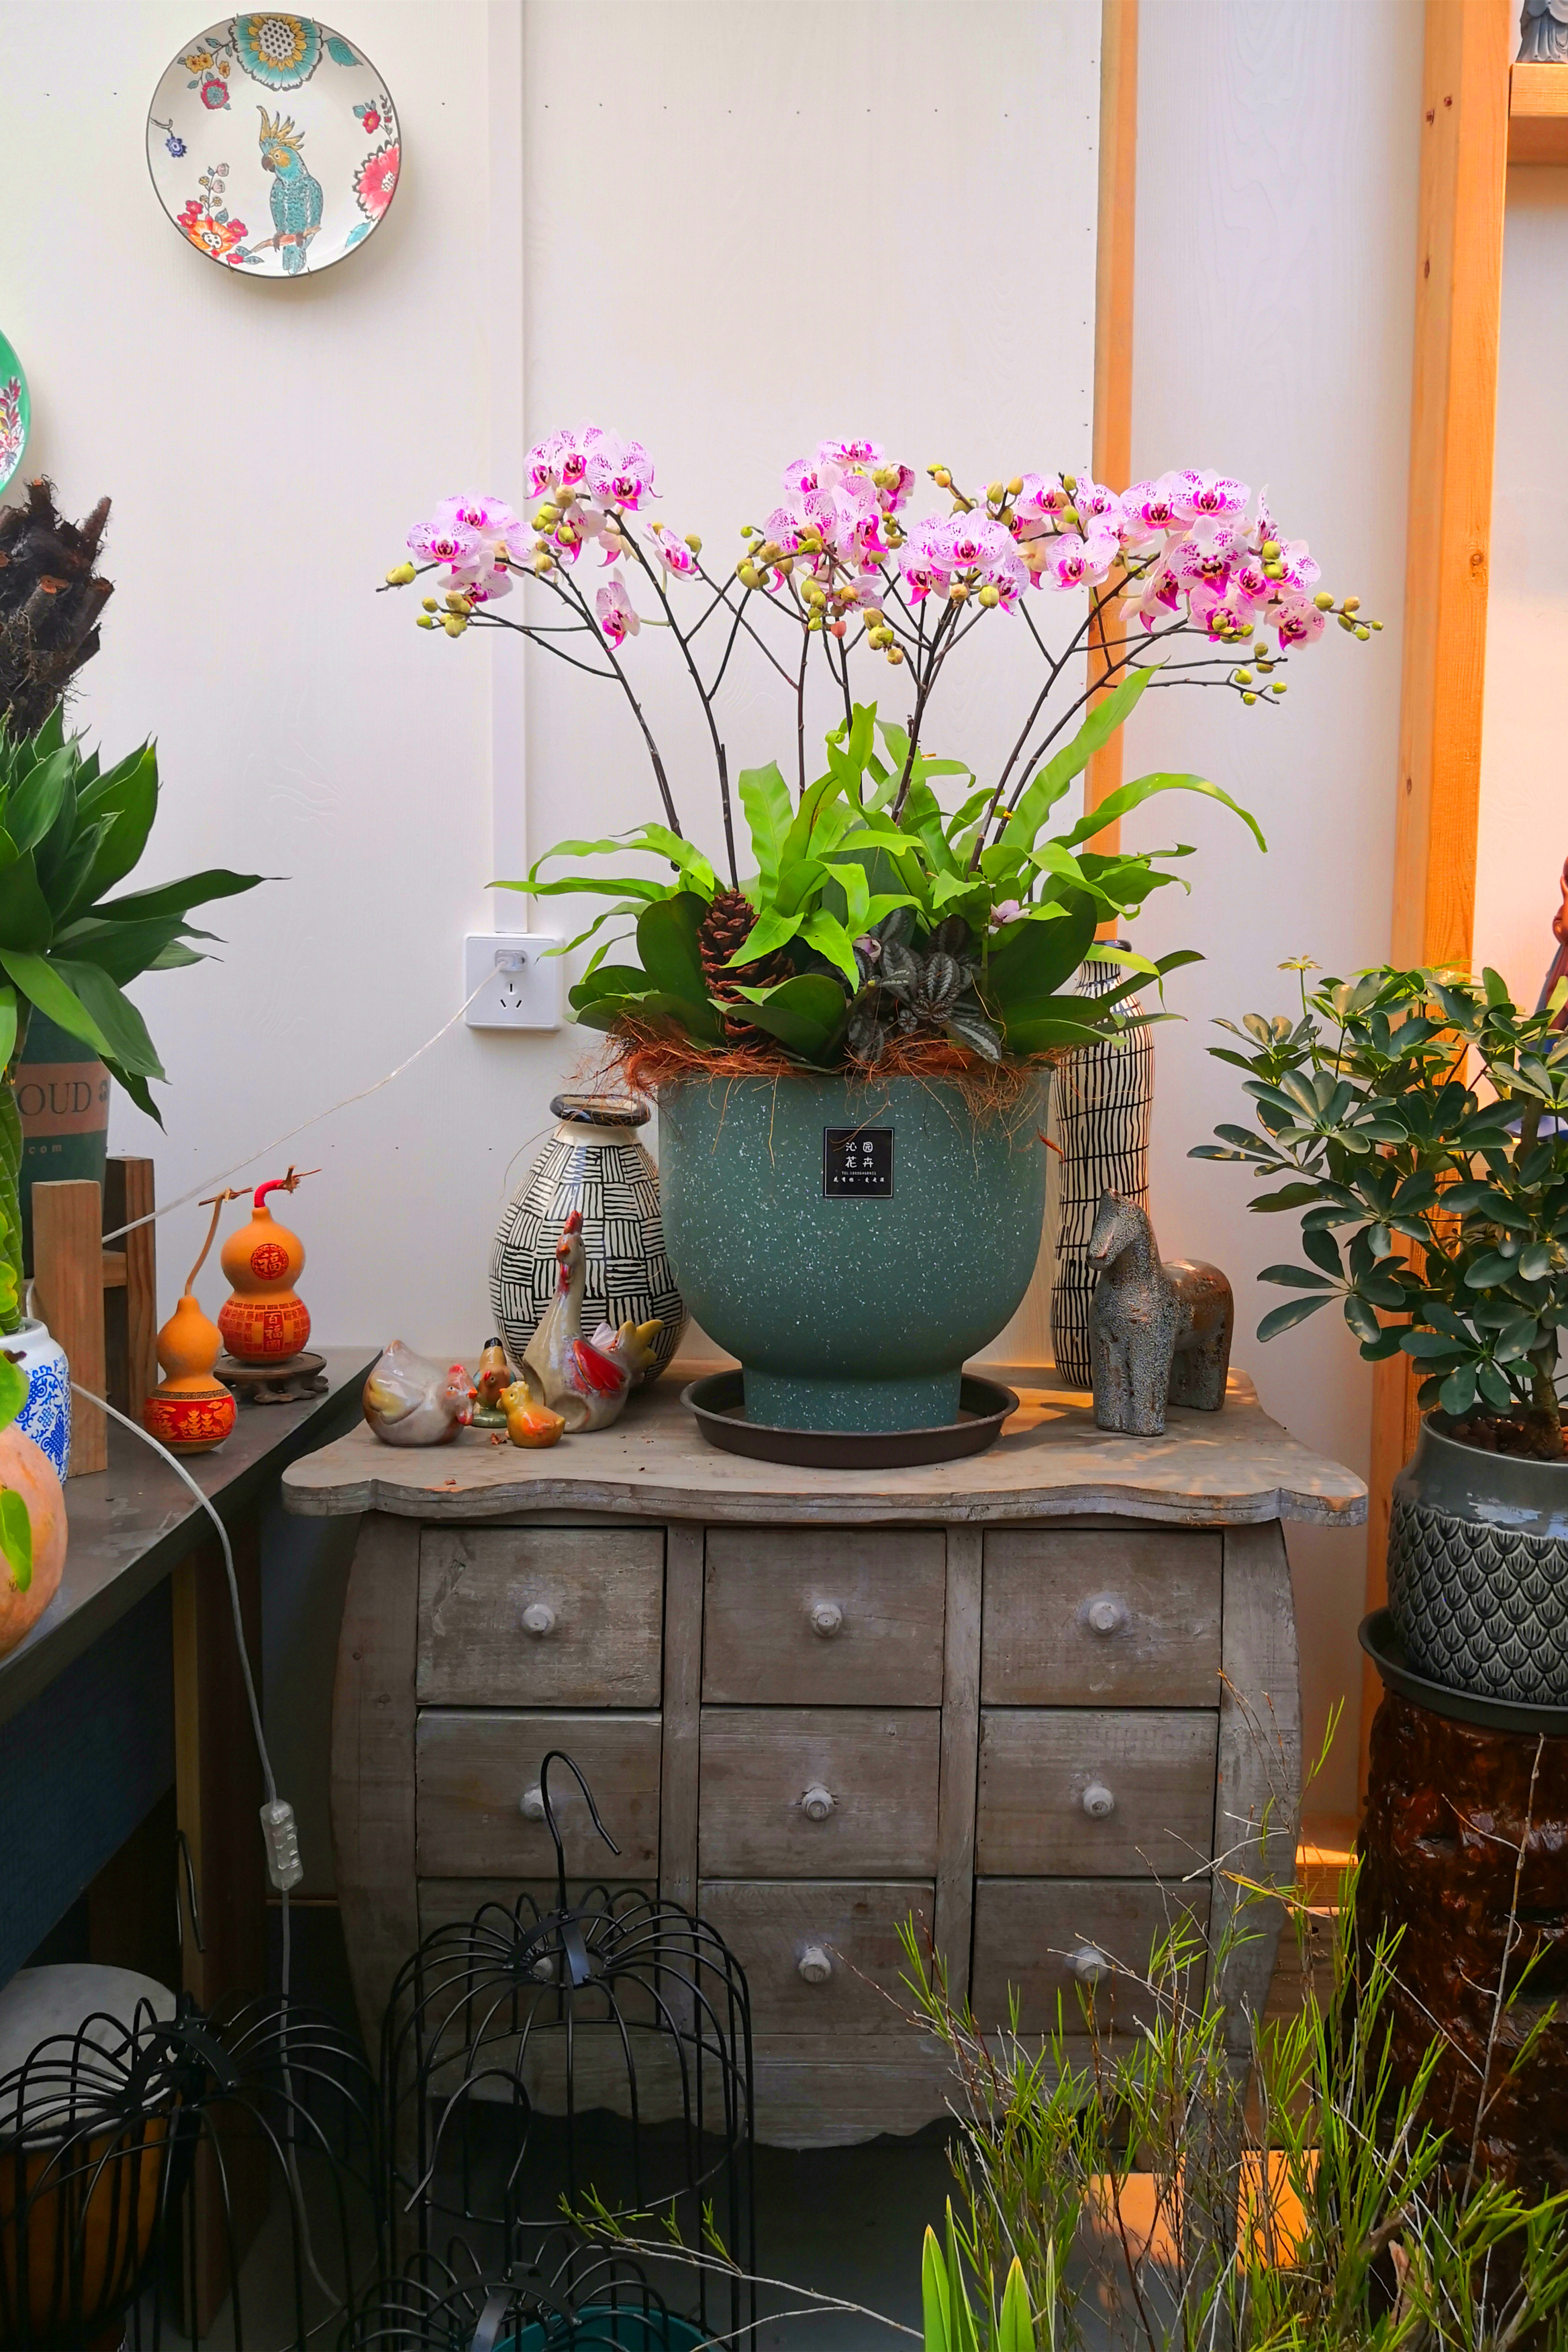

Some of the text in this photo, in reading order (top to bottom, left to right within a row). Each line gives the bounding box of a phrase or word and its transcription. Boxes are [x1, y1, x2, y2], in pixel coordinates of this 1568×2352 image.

[29, 1144, 62, 1154] com
[845, 1142, 873, 1153] 沁园
[845, 1156, 873, 1168] 花卉
[257, 1253, 281, 1272] 福
